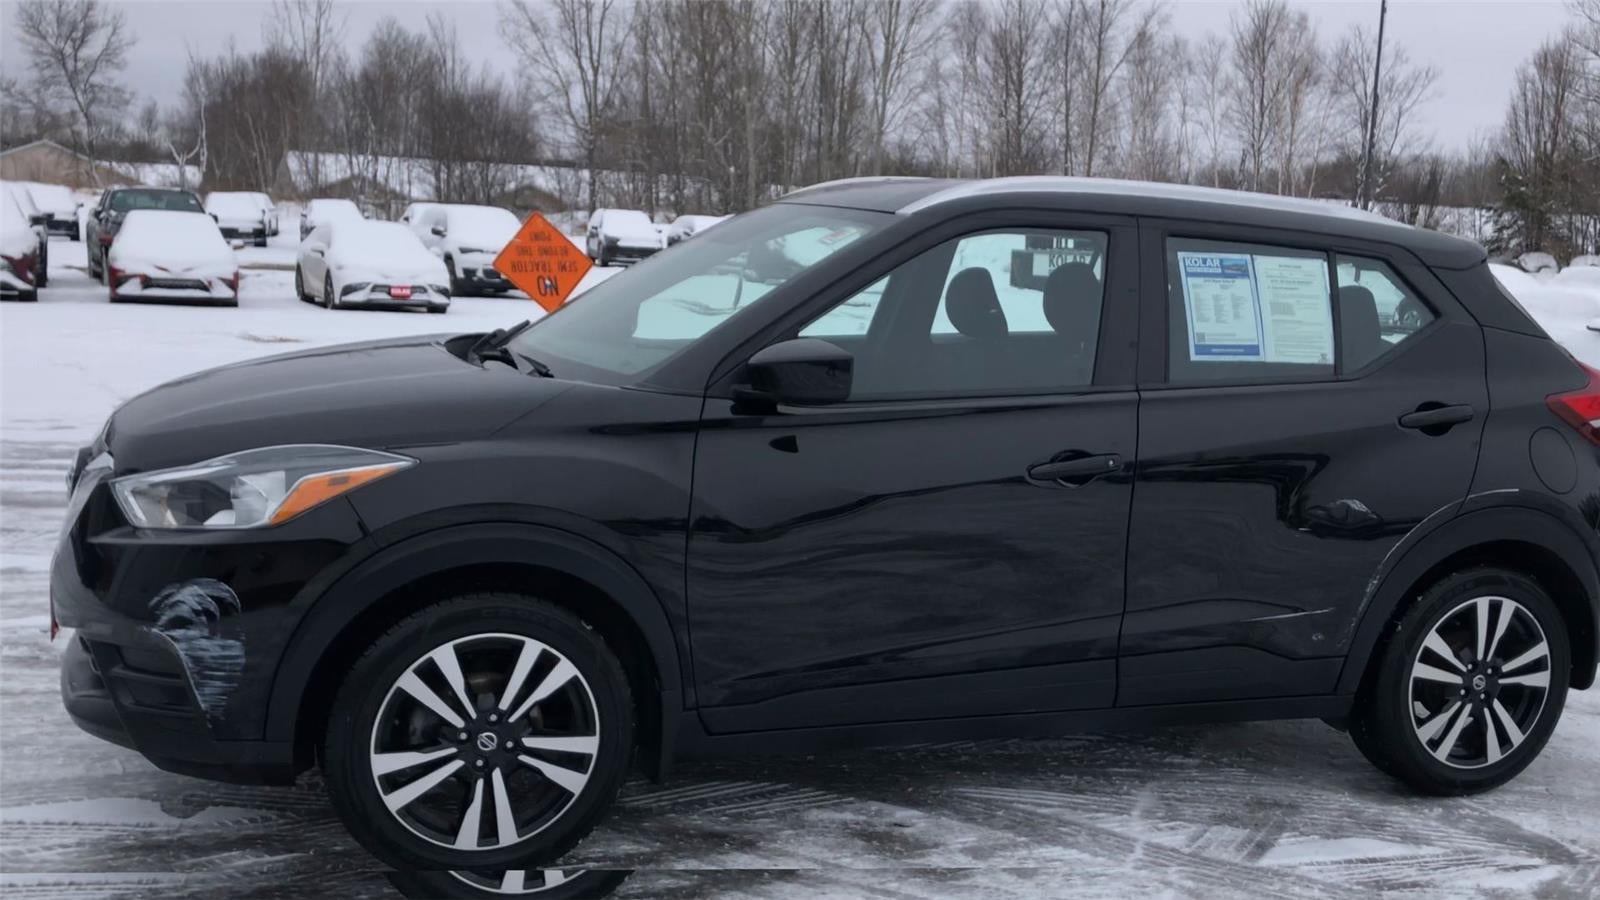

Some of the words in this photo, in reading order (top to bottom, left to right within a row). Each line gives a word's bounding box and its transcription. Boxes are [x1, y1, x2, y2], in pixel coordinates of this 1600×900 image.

[511, 260, 552, 273] TRACTOR
[558, 260, 578, 273] SEMI
[1184, 257, 1221, 268] KOLAR
[537, 275, 560, 297] NO
